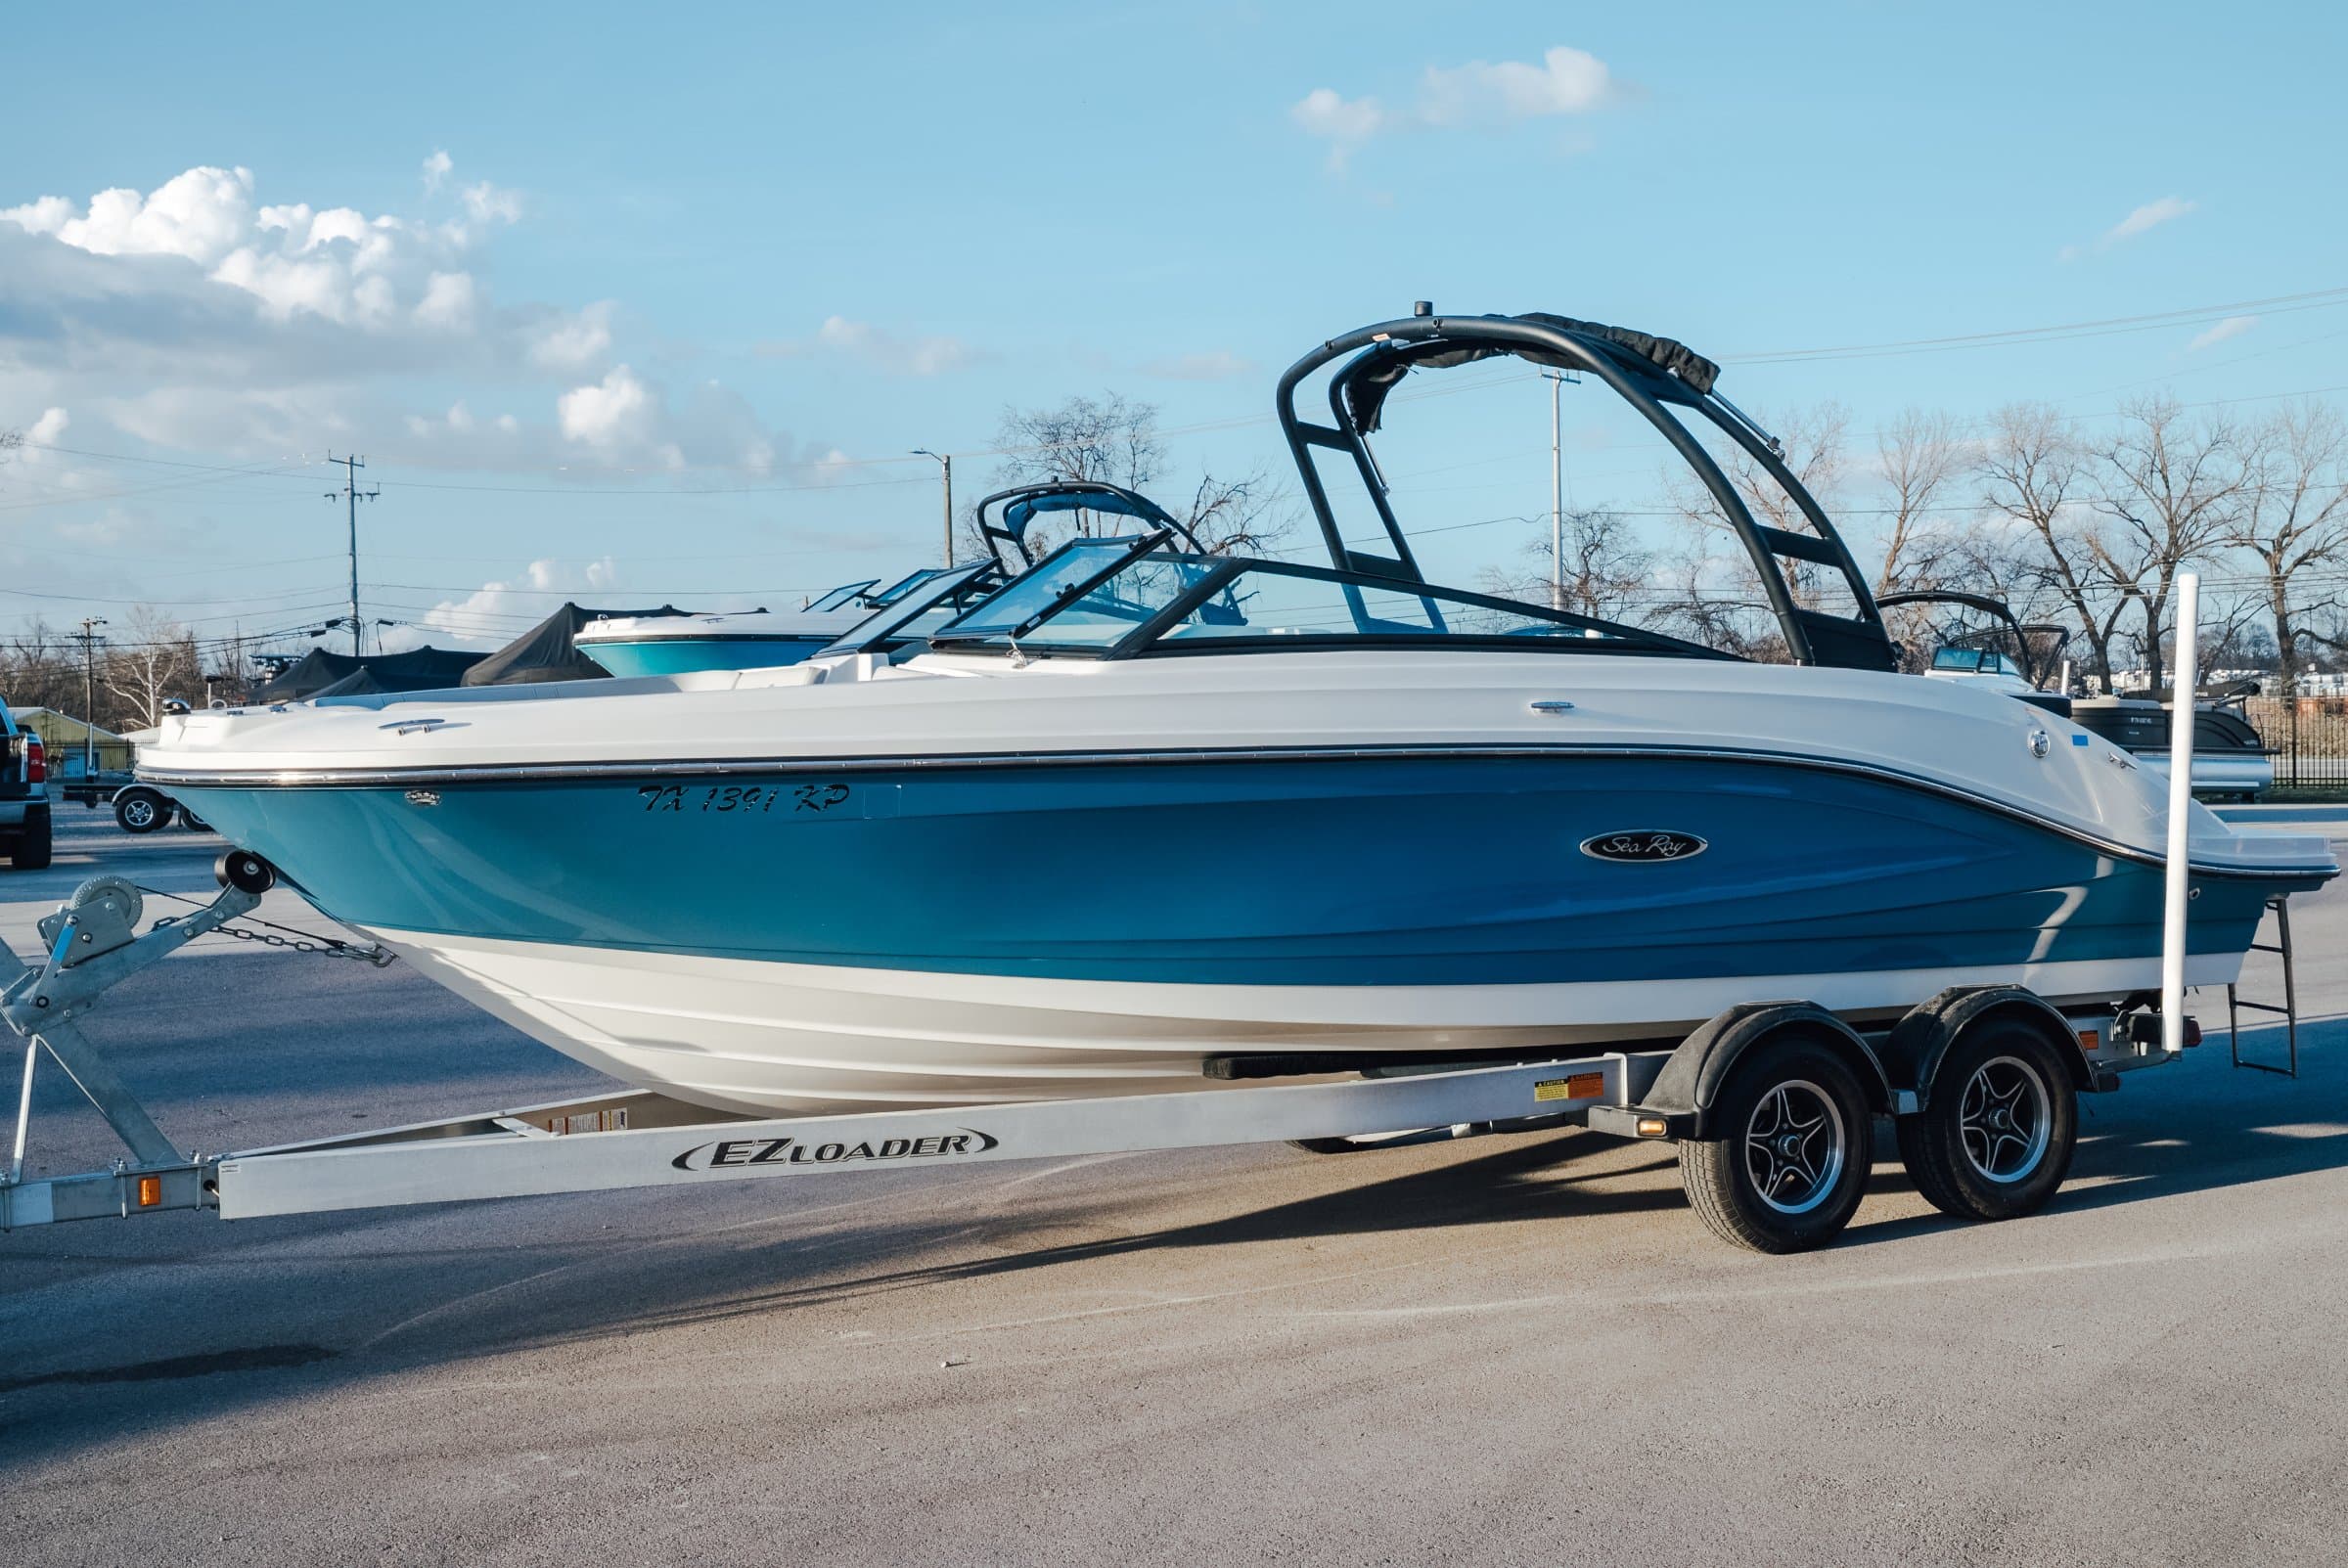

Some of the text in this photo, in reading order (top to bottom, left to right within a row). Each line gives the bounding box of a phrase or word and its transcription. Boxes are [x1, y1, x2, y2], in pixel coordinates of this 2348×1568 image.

[638, 784, 689, 812] TX
[702, 786, 779, 813] 1391
[1602, 834, 1687, 857] Sea Ray
